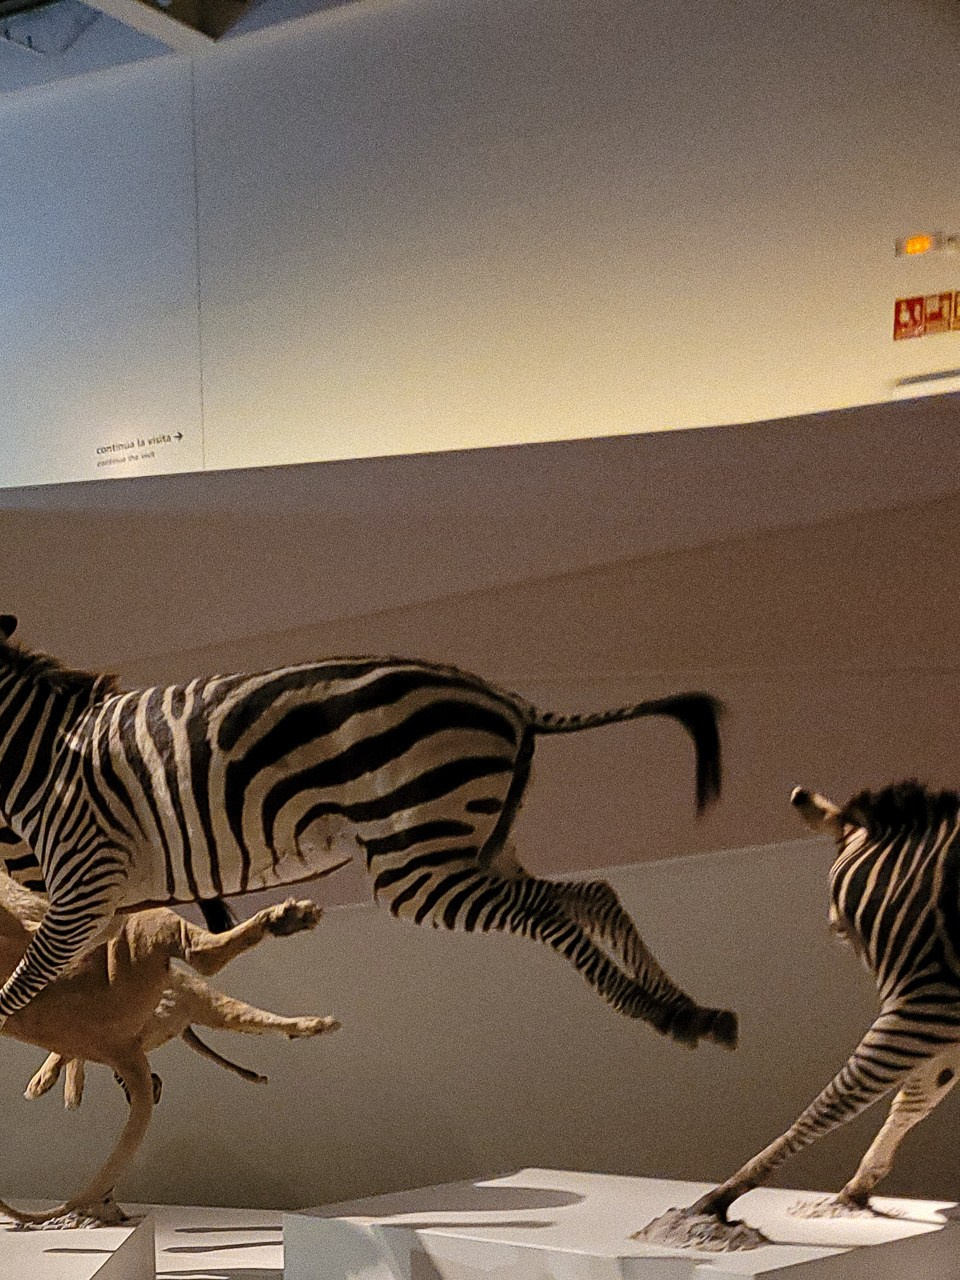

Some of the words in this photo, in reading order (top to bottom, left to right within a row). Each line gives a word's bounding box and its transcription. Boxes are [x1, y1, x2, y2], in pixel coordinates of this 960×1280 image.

[96, 442, 135, 455] continua
[137, 438, 145, 447] la
[148, 435, 171, 446] visita
